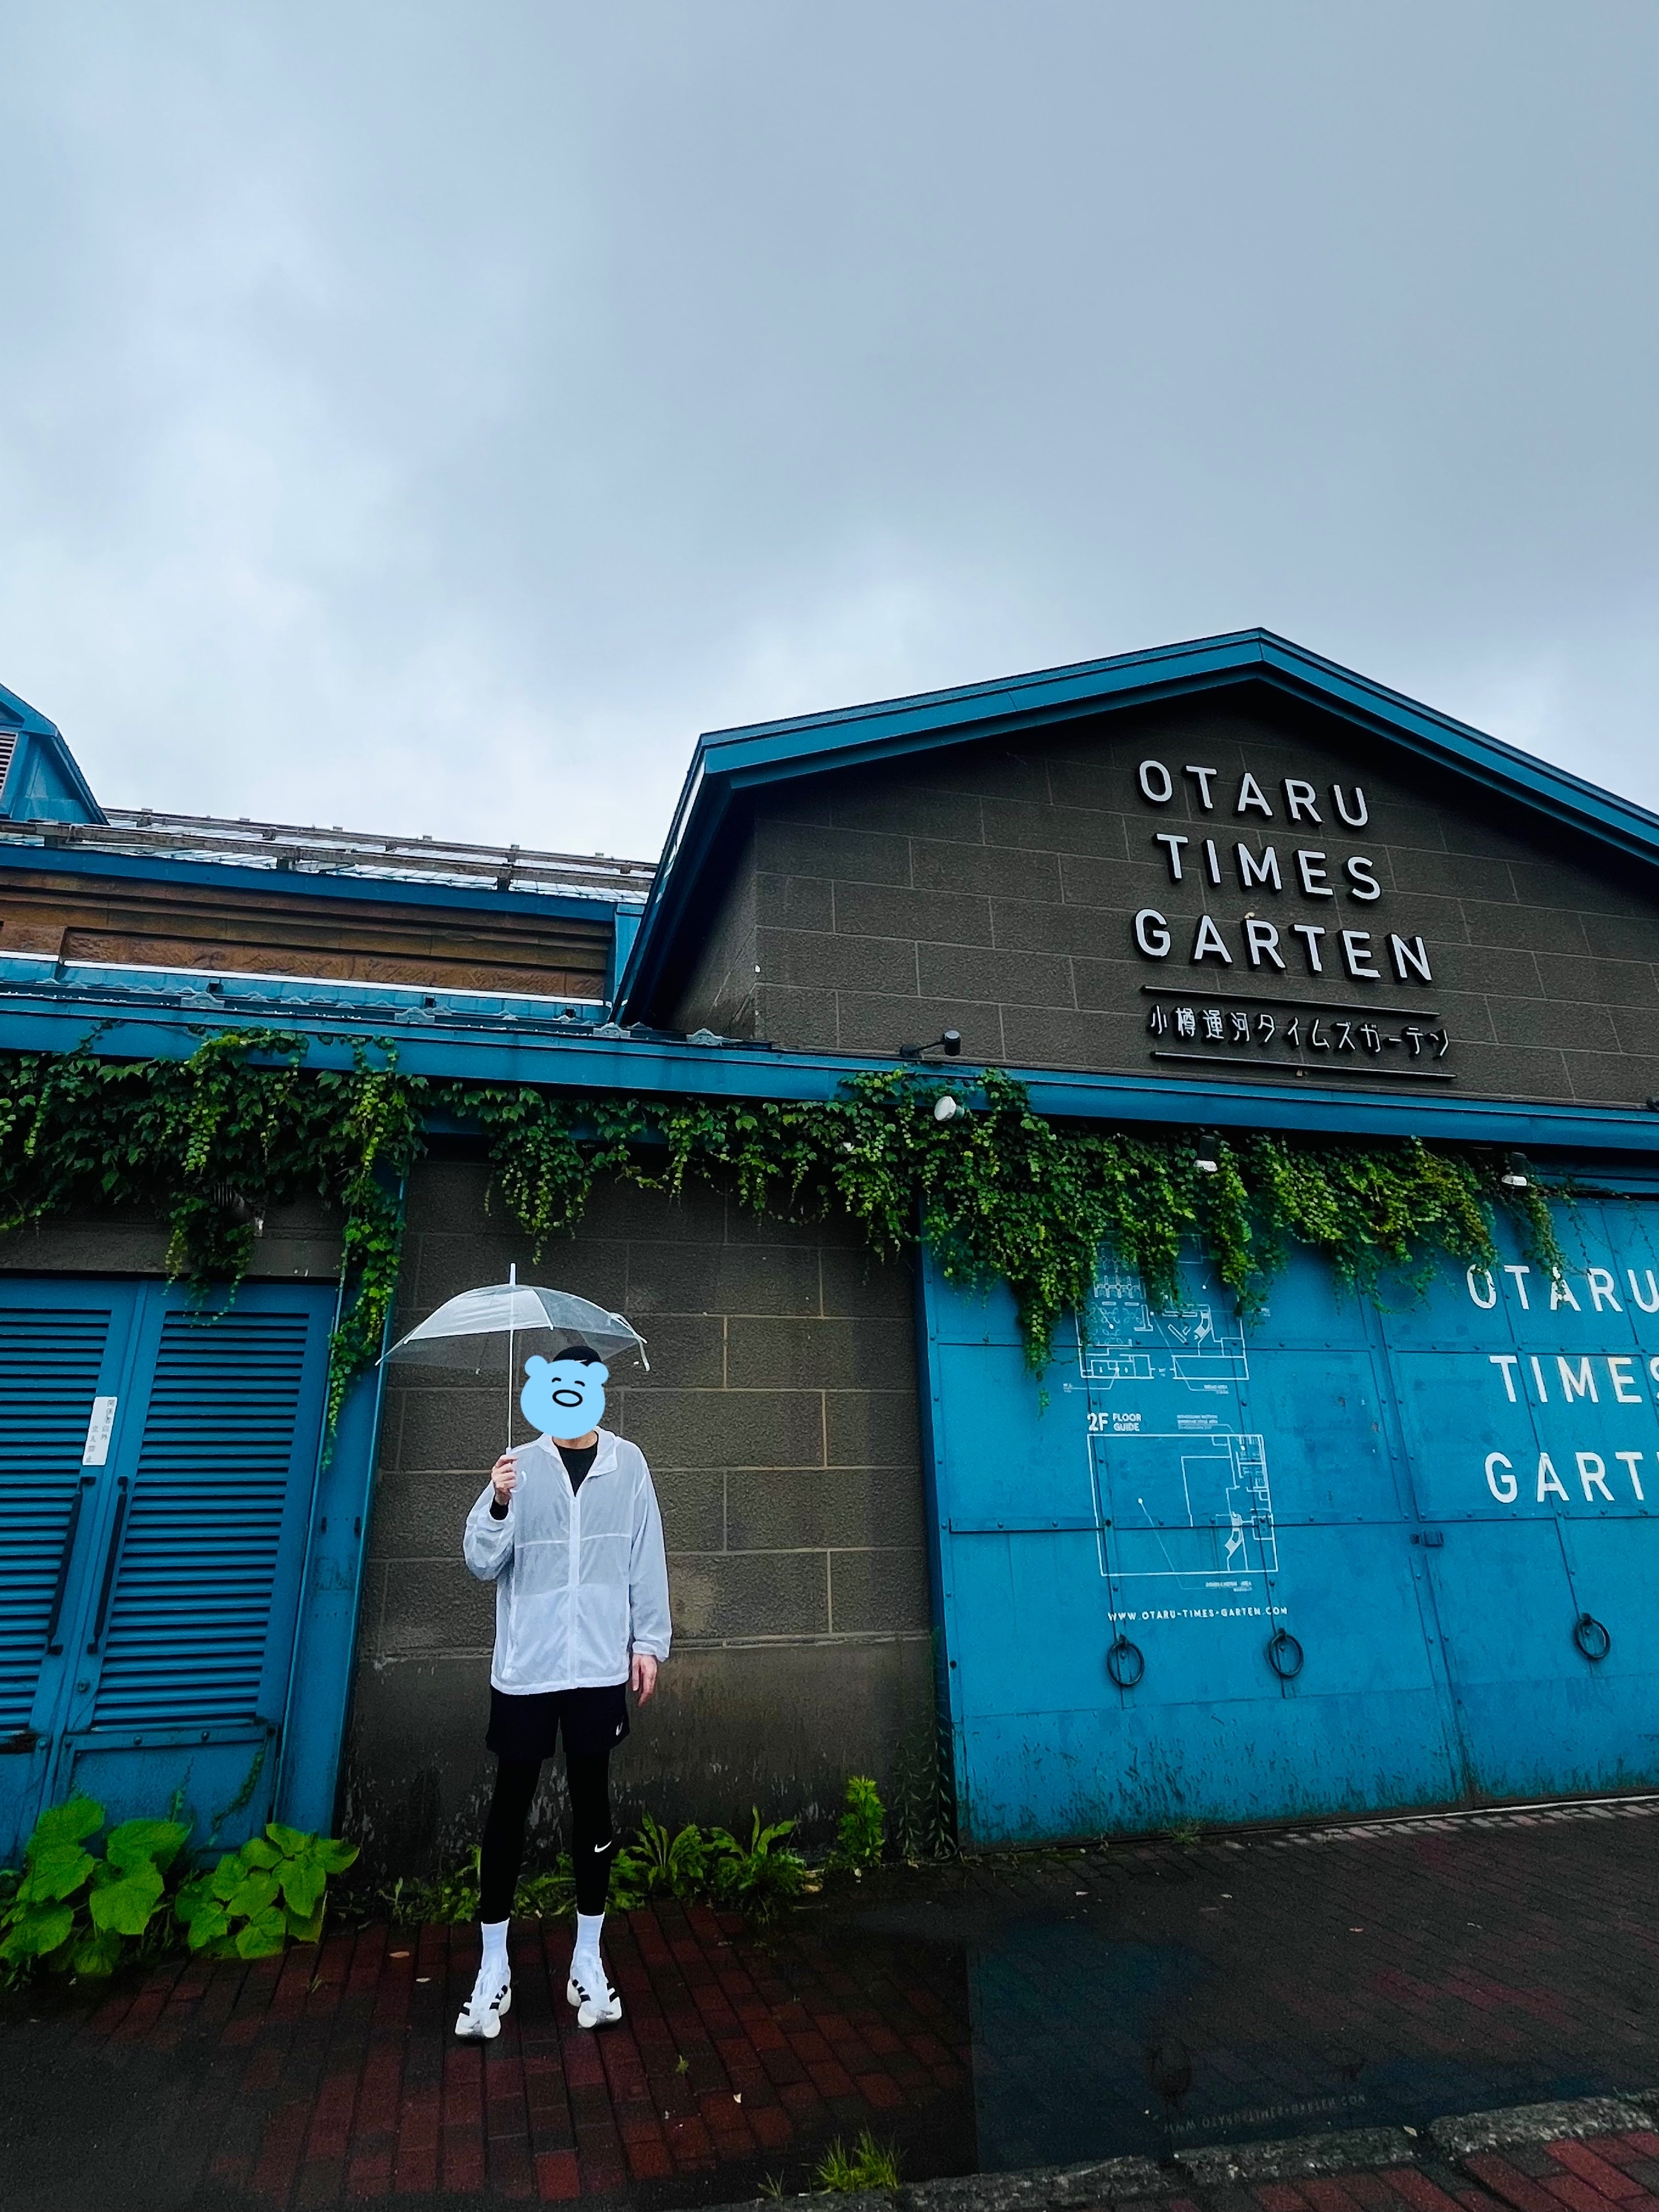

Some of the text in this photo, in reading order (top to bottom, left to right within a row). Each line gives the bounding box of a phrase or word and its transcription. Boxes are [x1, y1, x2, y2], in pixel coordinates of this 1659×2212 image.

[1138, 760, 1370, 827] OTARU
[1156, 833, 1381, 900] TIMES
[1135, 909, 1432, 981] GARTEN
[1466, 1263, 1659, 1314] OTARU
[1489, 1354, 1659, 1404] TIME
[1087, 1412, 1141, 1432] 2F FLOOR
[1113, 1423, 1140, 1432] GUIDE
[1484, 1451, 1659, 1503] GART
